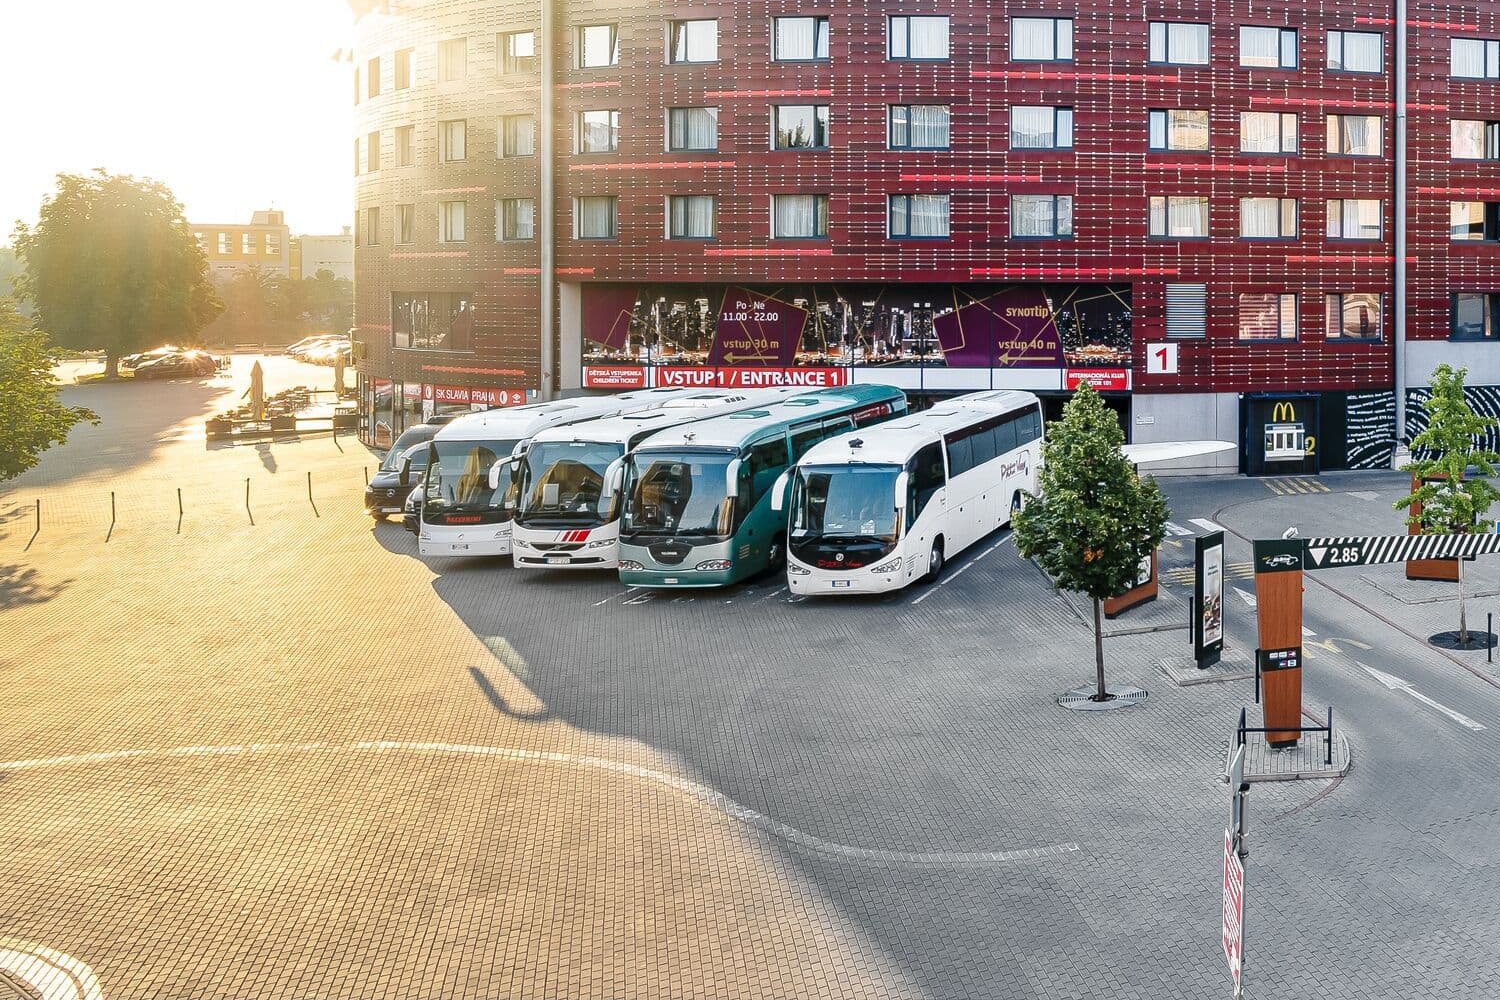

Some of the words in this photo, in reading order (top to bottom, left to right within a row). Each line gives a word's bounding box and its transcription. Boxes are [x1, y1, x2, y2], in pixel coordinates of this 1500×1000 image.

[736, 301, 747, 310] Po
[753, 301, 765, 310] Ne
[723, 313, 747, 321] 11.00
[754, 313, 778, 321] 22.00
[723, 341, 751, 351] vstup
[754, 340, 767, 348] 30
[999, 341, 1027, 351] vstup
[1029, 340, 1043, 350] 40
[1046, 342, 1056, 350] m
[1155, 347, 1167, 371] 1
[664, 370, 714, 385] VSTUP
[717, 371, 724, 385] 1
[730, 370, 737, 385] /
[742, 370, 825, 385] ENTRANCE
[831, 370, 838, 385] 1
[436, 389, 445, 399] SK
[446, 389, 468, 400] SLAVIA
[472, 391, 495, 402] PRAHA
[1305, 436, 1316, 456] 2
[1329, 547, 1359, 563] 2.85
